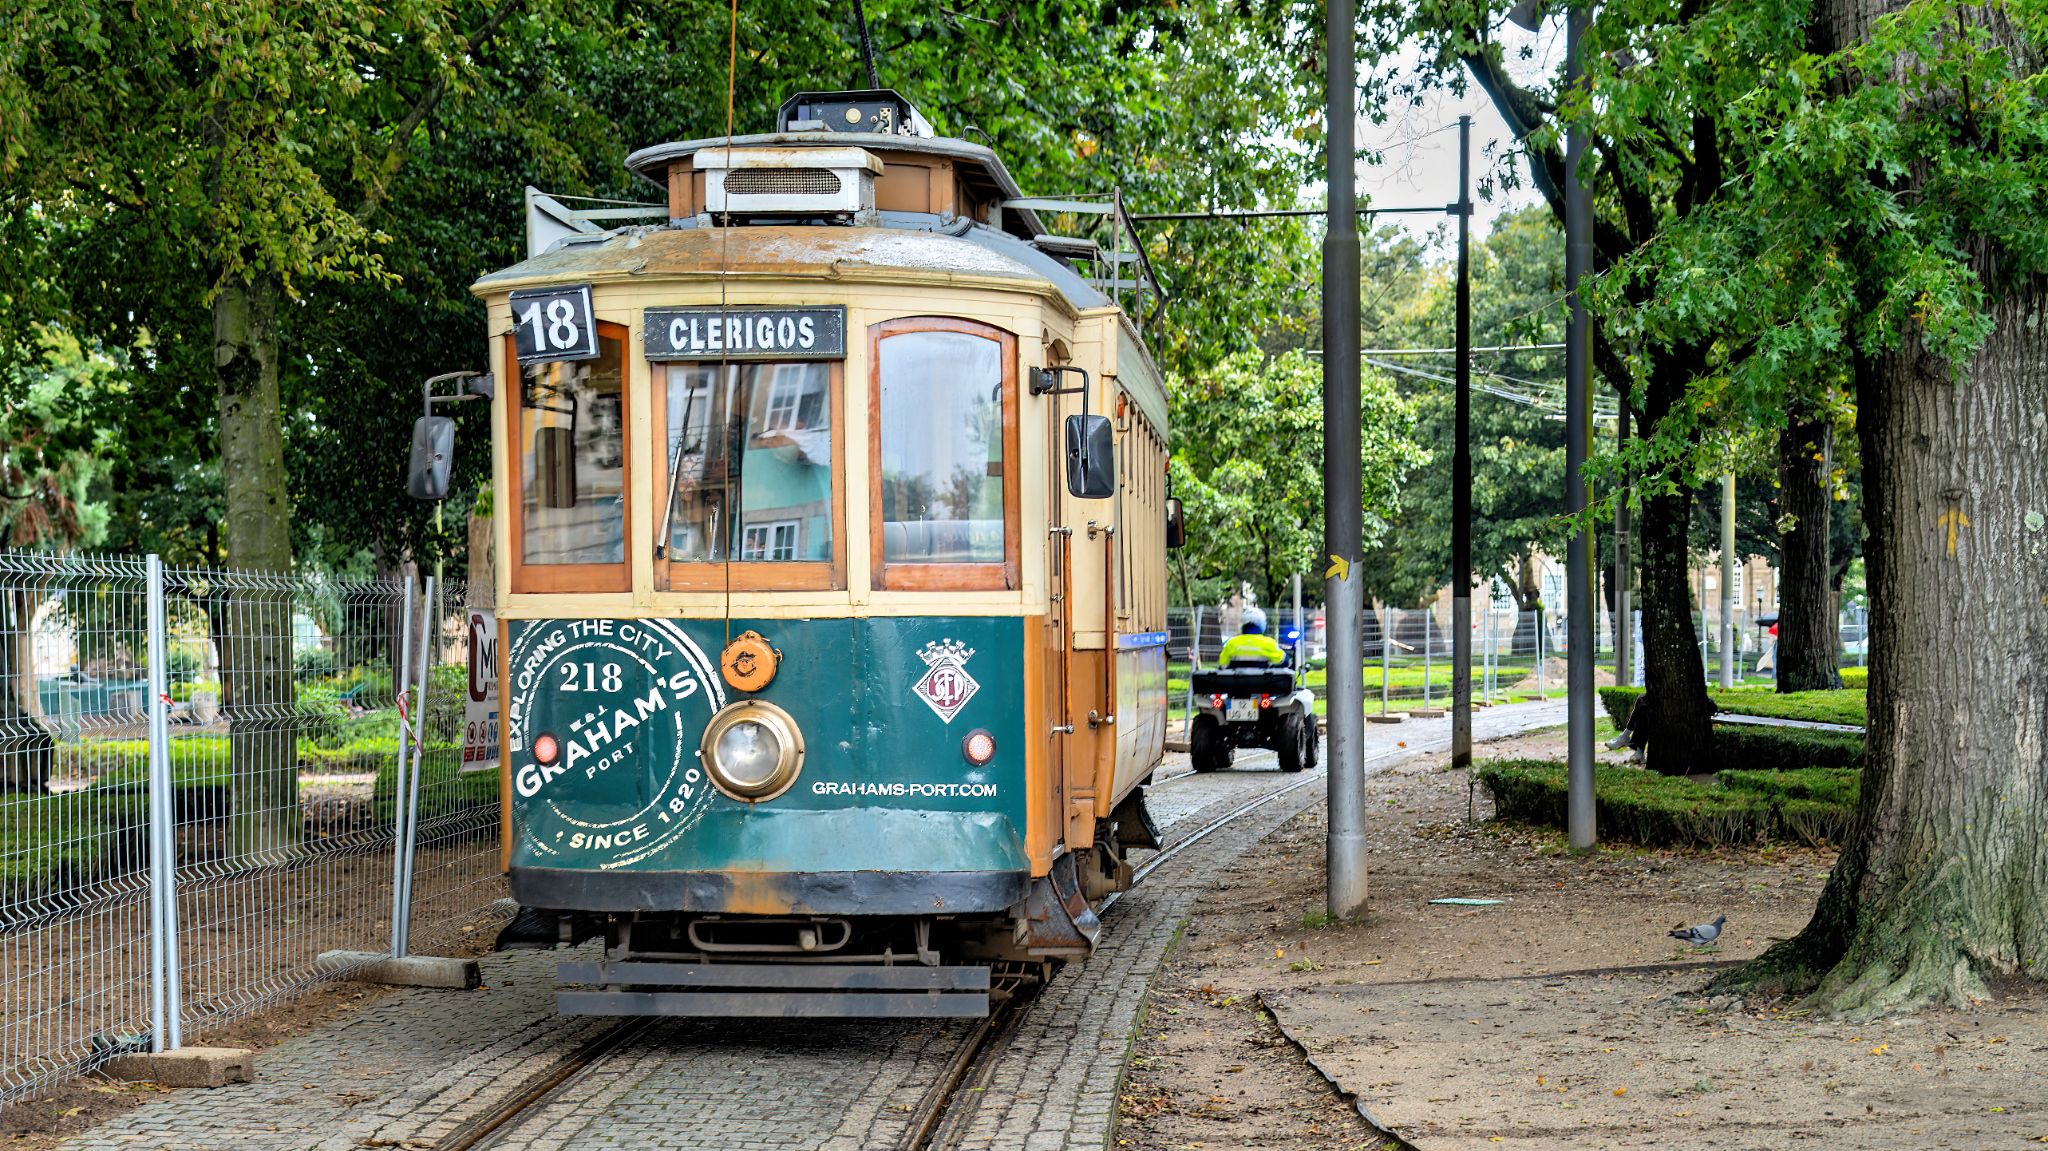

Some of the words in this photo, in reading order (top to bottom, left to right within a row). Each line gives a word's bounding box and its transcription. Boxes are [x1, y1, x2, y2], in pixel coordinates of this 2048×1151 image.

[519, 299, 579, 352] 18
[669, 316, 815, 350] CLERIGOS
[509, 629, 567, 752] EXPLORING
[567, 620, 613, 639] THE
[619, 625, 672, 661] CITY
[559, 662, 623, 693] 218
[586, 742, 634, 779] PORT
[812, 782, 997, 797] GRAHAMS-PORT.COM
[569, 823, 650, 850] SINCE
[657, 768, 700, 824] 1820
